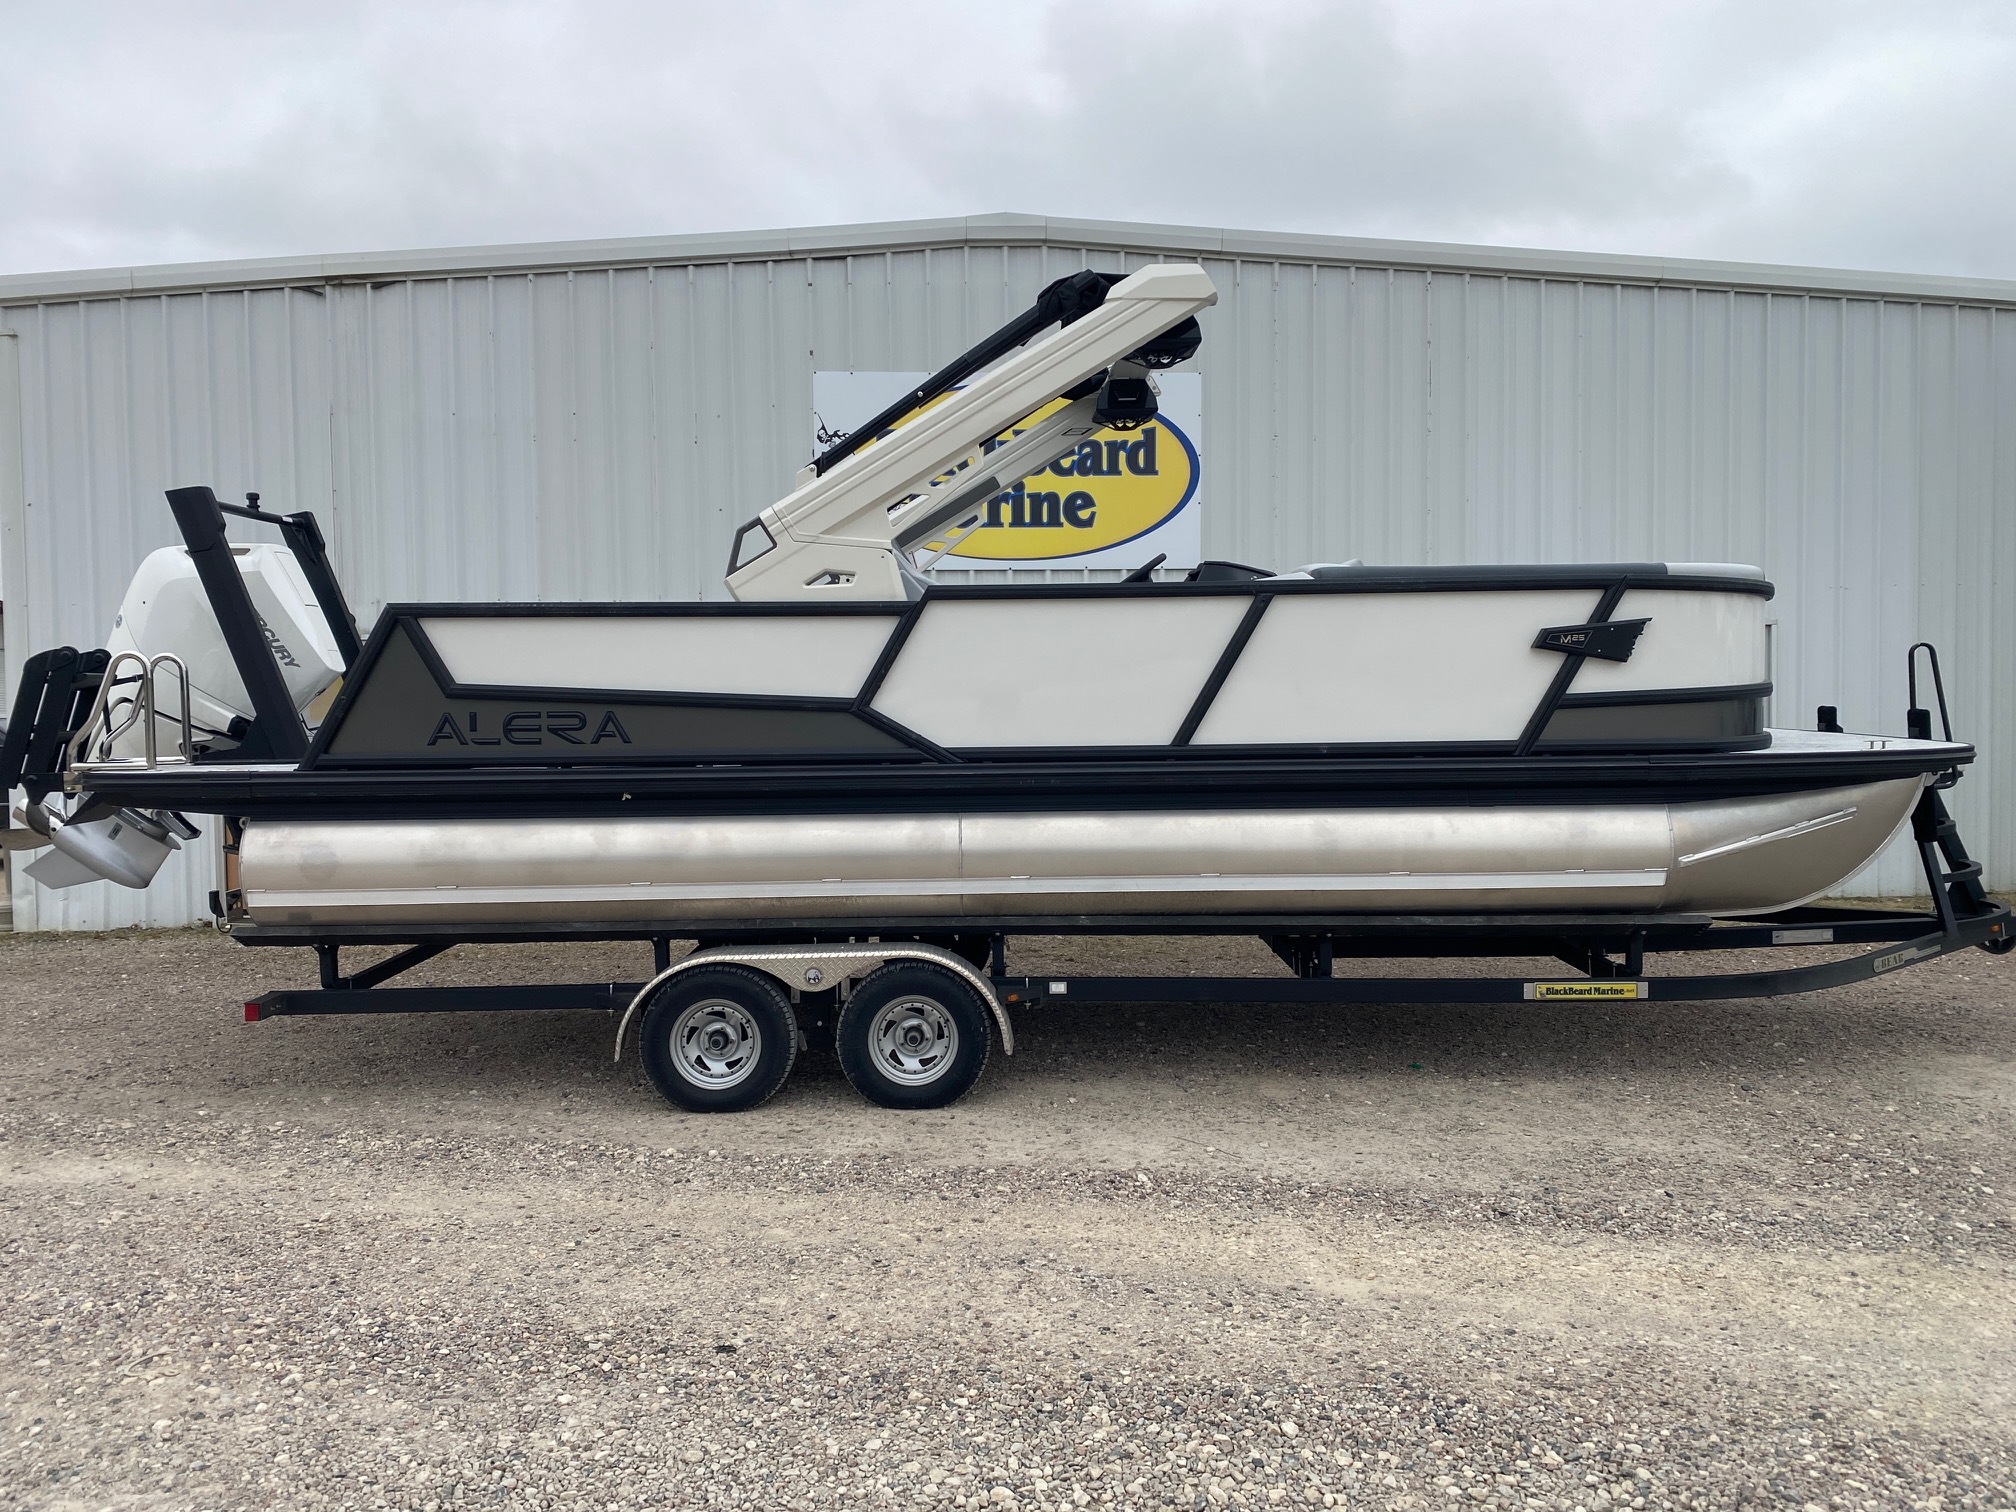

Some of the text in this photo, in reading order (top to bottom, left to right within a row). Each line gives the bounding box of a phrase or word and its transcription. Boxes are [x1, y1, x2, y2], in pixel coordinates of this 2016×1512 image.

[976, 481, 1097, 529] rine
[1560, 634, 1586, 644] M25
[427, 710, 633, 747] ALERA
[1545, 986, 1593, 996] BlackBeard
